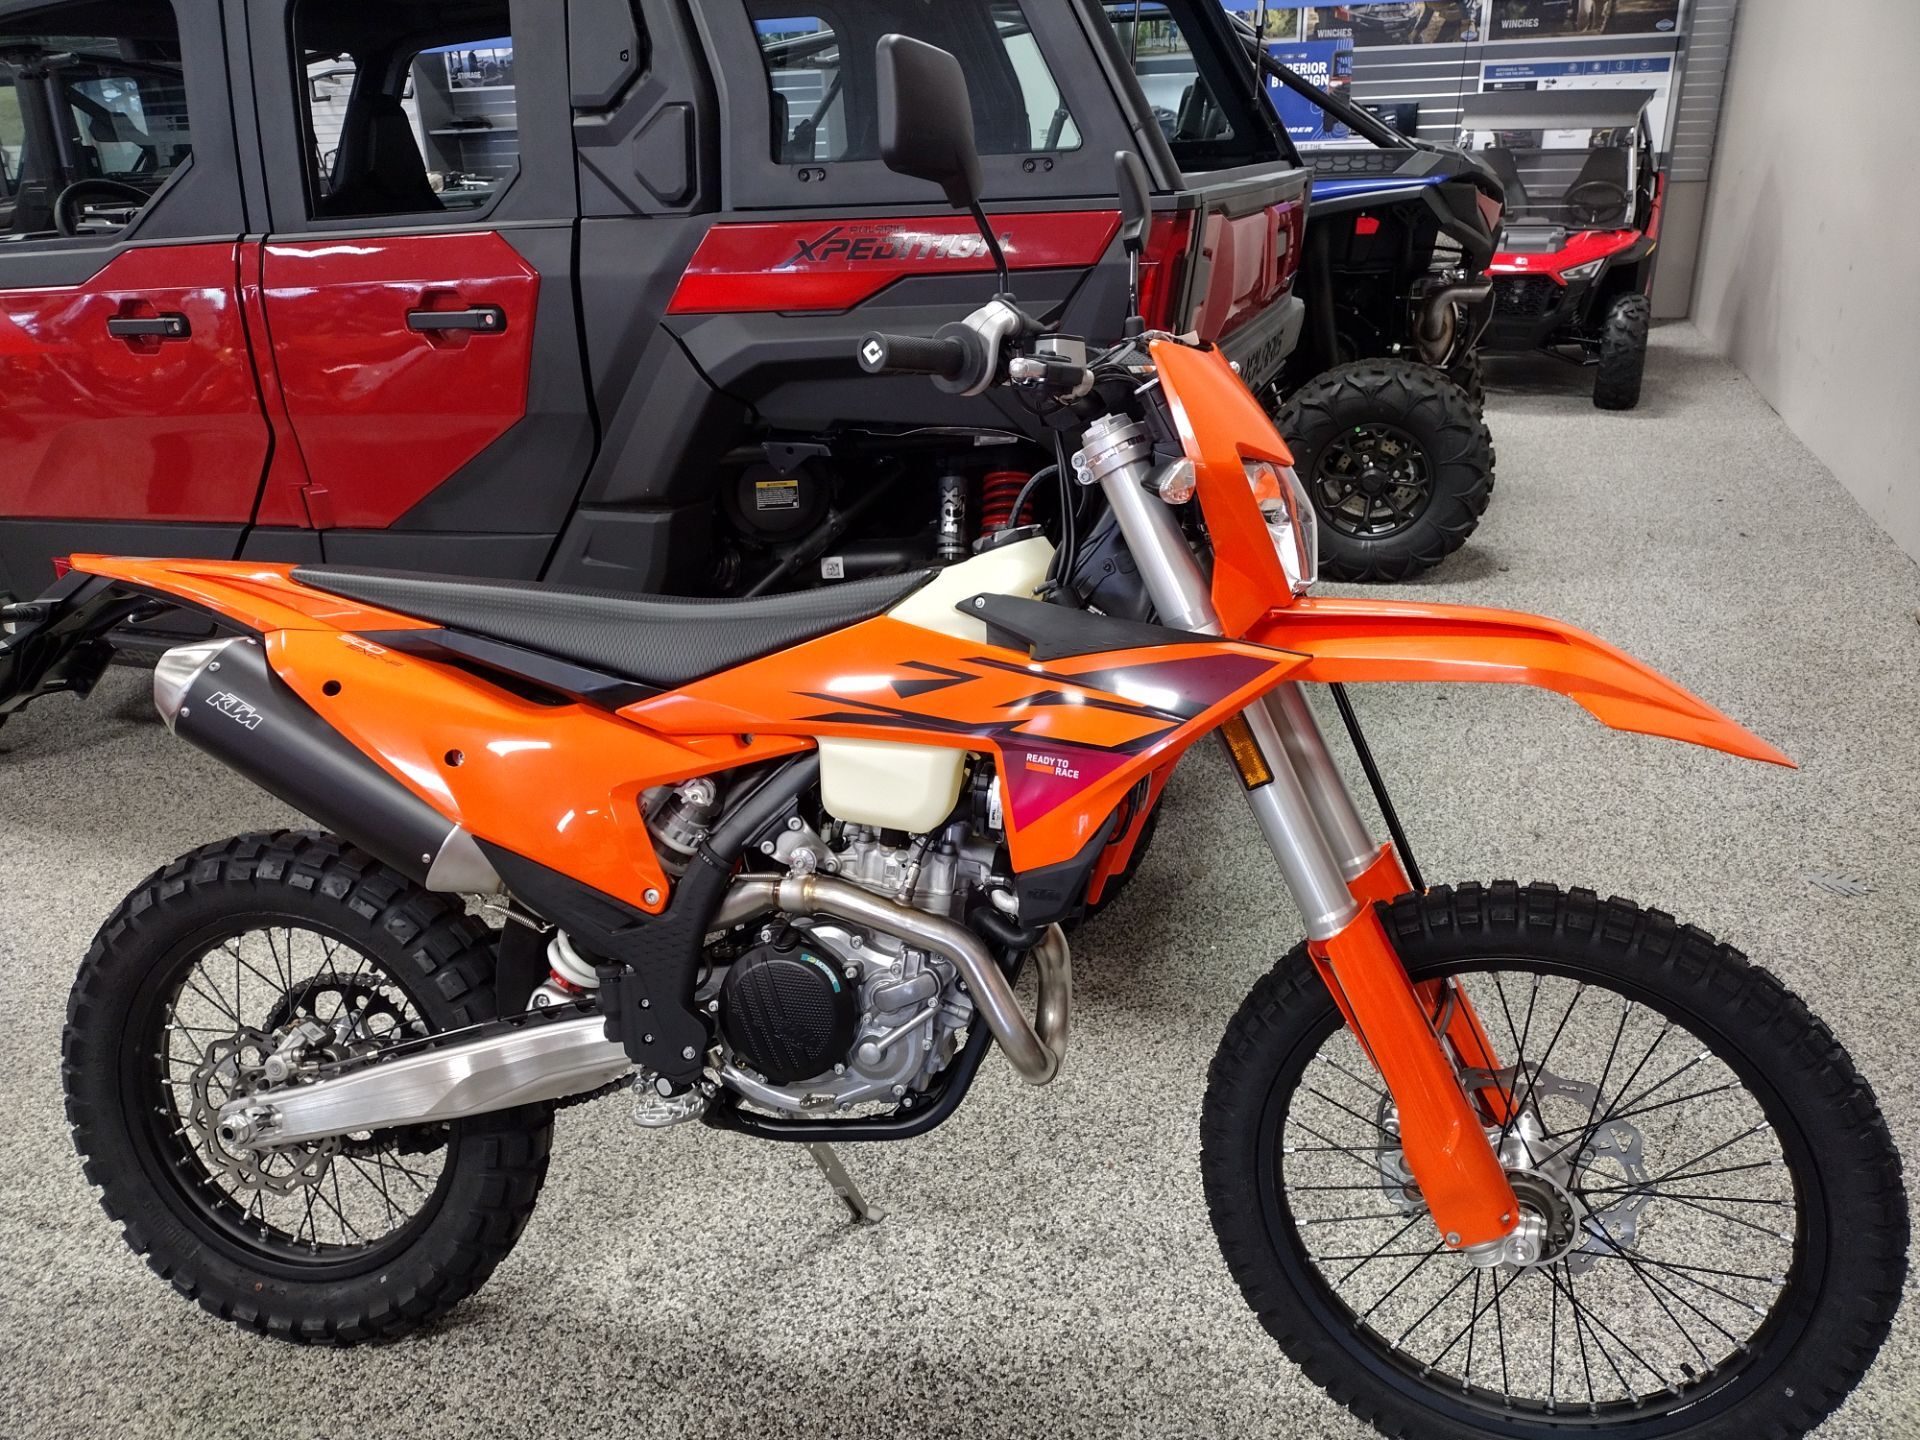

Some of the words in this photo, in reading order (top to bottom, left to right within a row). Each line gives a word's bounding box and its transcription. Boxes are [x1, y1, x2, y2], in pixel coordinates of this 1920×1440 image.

[1501, 18, 1540, 29] WINCHES
[1317, 28, 1353, 38] WINCHES
[1283, 62, 1327, 75] PERIOR
[1286, 126, 1314, 134] NGER
[336, 634, 387, 655] 500
[205, 690, 264, 731] KTM
[1026, 753, 1056, 766] READY
[1056, 758, 1069, 769] TO
[1055, 767, 1080, 780] RACE
